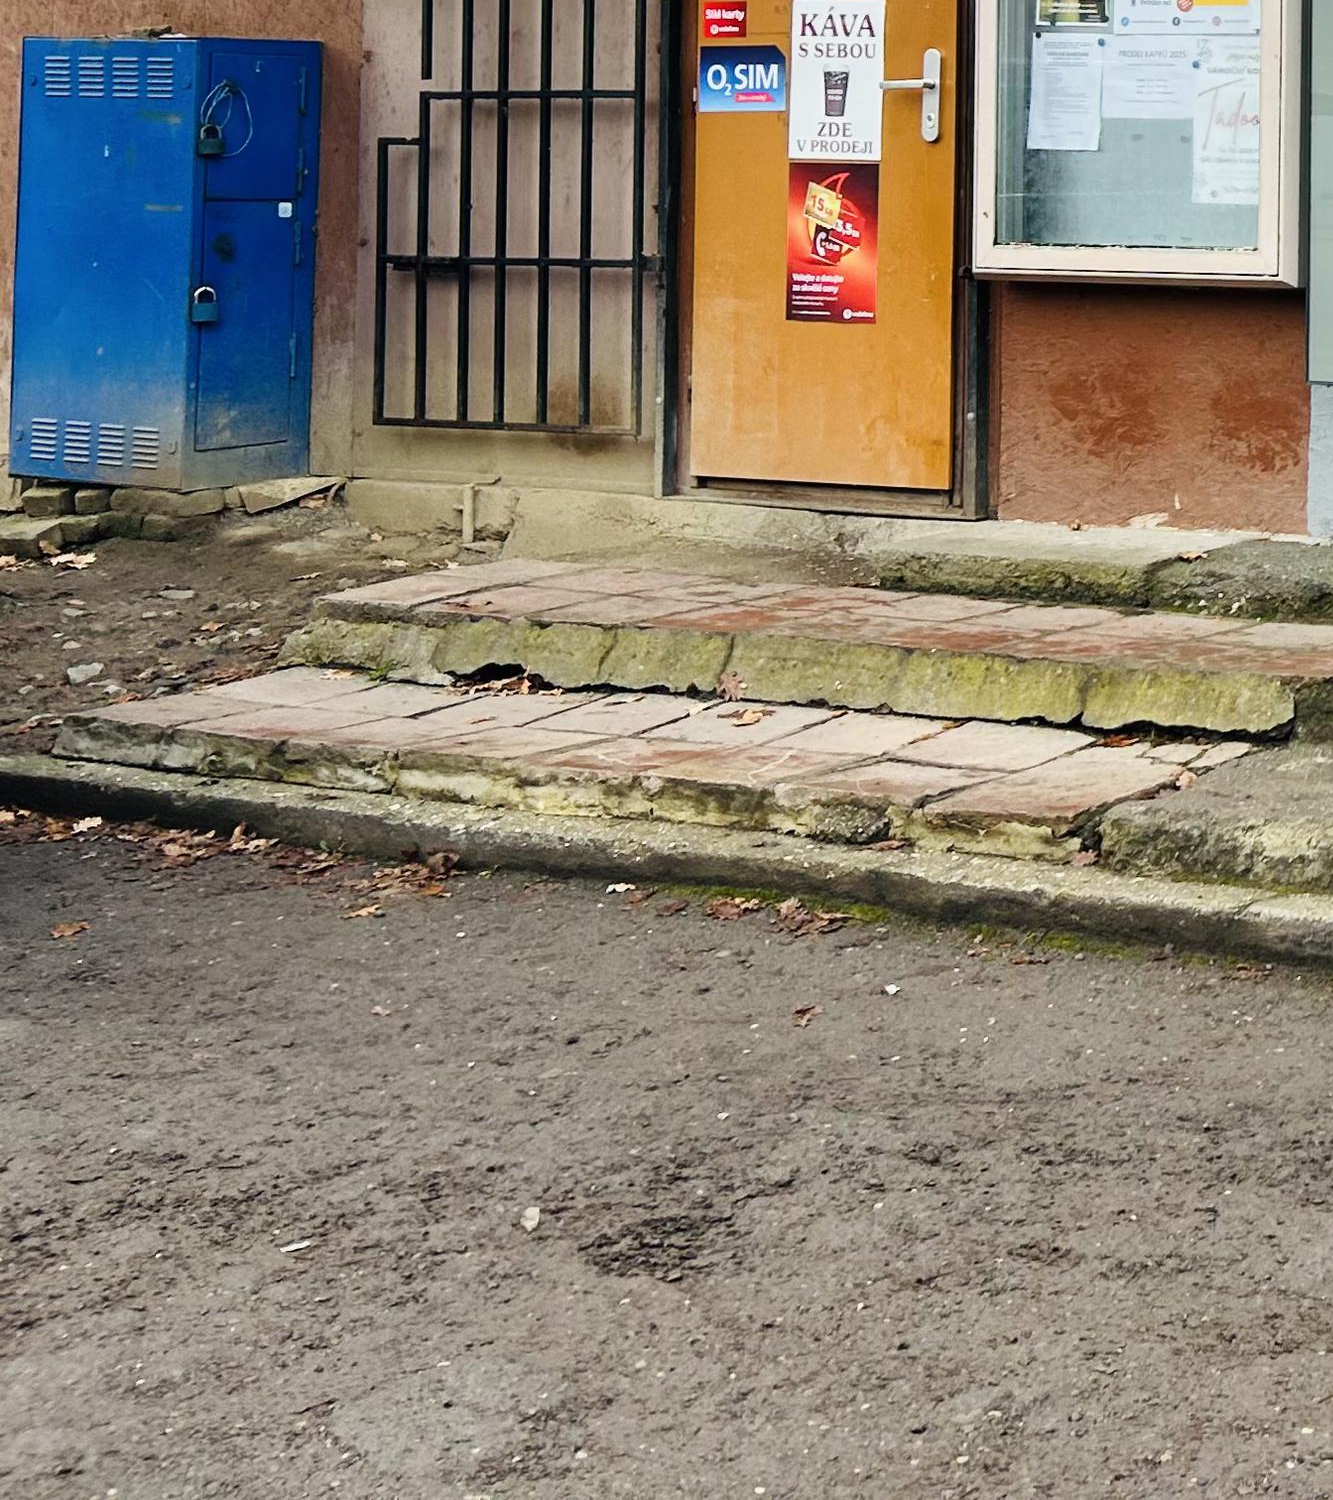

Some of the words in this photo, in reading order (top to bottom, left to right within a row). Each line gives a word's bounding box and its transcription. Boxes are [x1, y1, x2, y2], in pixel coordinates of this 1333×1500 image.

[705, 8, 722, 20] SIM
[722, 8, 745, 21] karty
[799, 6, 876, 38] KÁVA
[799, 43, 809, 59] S
[814, 43, 876, 59] SEBOU
[734, 63, 779, 90] SIM
[817, 122, 853, 138] ZDE
[797, 140, 807, 153] V
[810, 140, 873, 154] PRODEJI
